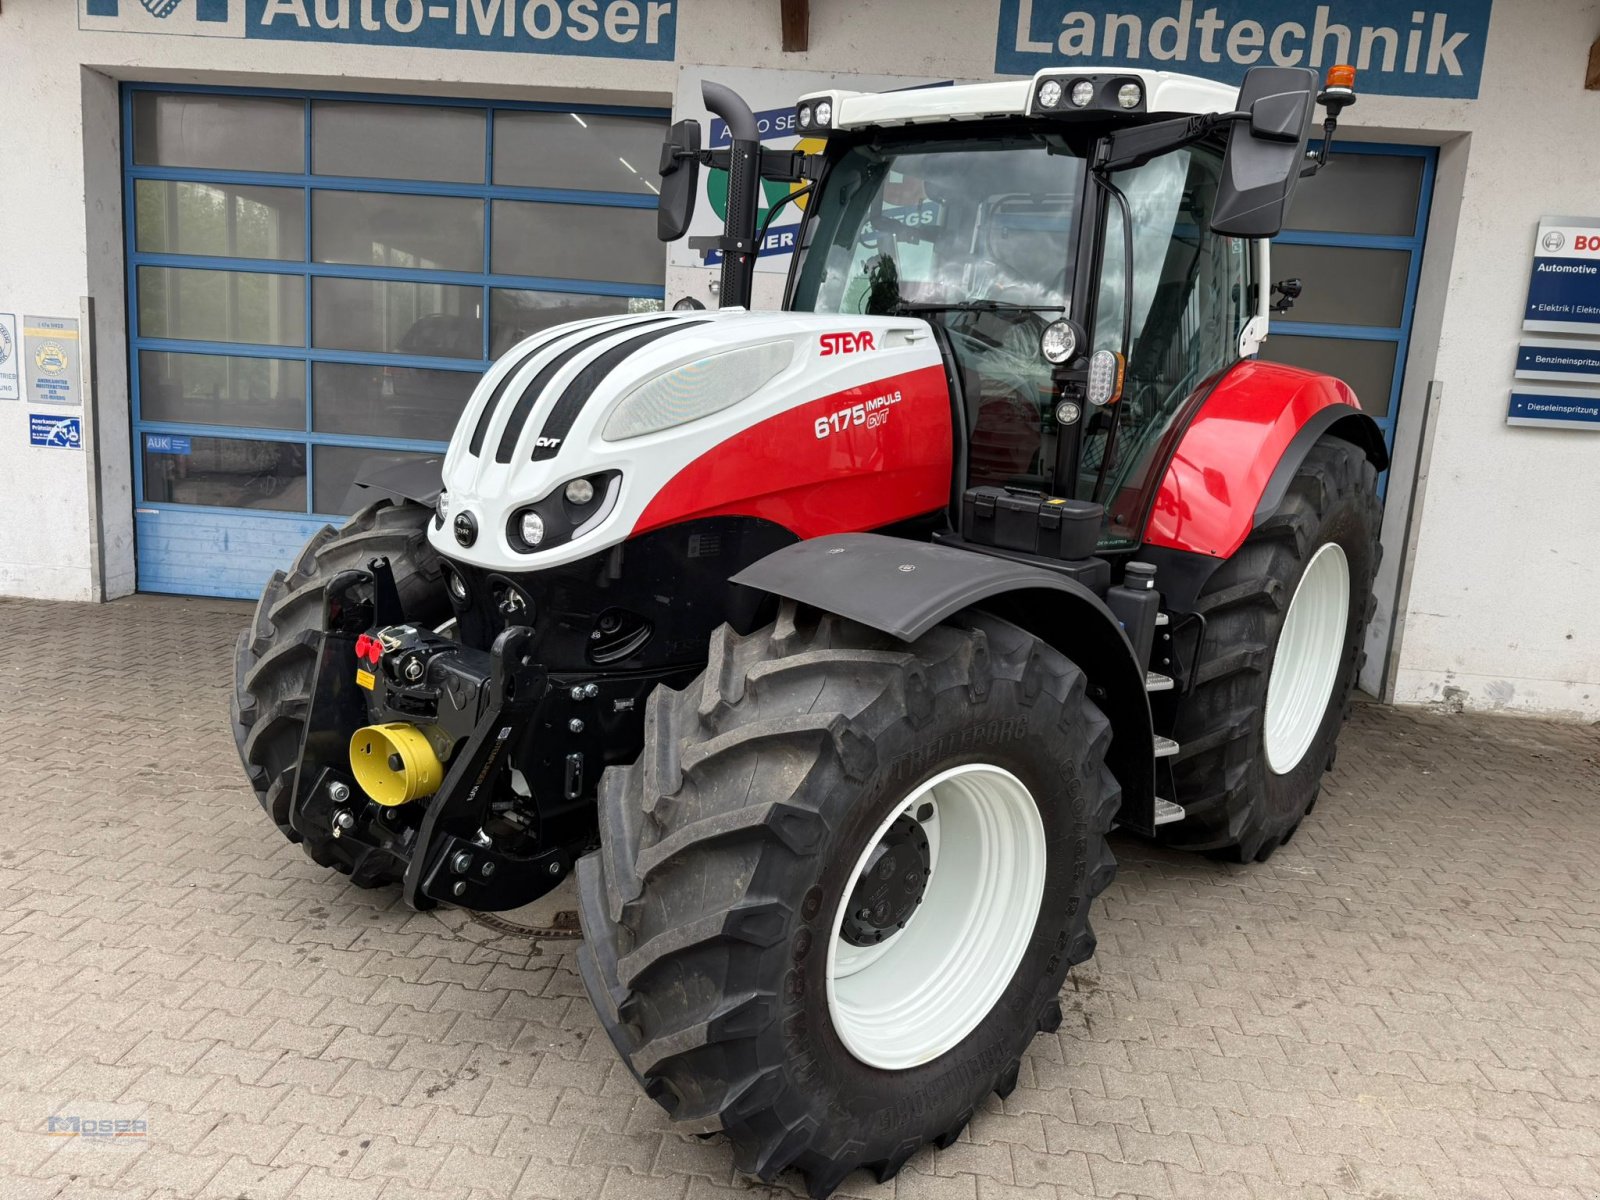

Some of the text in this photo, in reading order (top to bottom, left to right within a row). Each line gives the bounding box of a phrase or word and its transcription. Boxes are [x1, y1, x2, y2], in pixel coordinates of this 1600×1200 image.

[260, 0, 672, 45] Auto-Moser
[1015, 0, 1470, 77] Landtechnik
[719, 119, 770, 140] AO
[1537, 262, 1598, 274] Automotive
[1538, 303, 1570, 313] Elektrik
[819, 330, 877, 357] STEYR
[1535, 354, 1600, 367] Benzineinspritzu
[814, 391, 902, 439] 6175 IMPULS
[867, 408, 890, 429] CVT
[1527, 402, 1599, 416] Dieseleinspritzung
[536, 436, 561, 448] CVT
